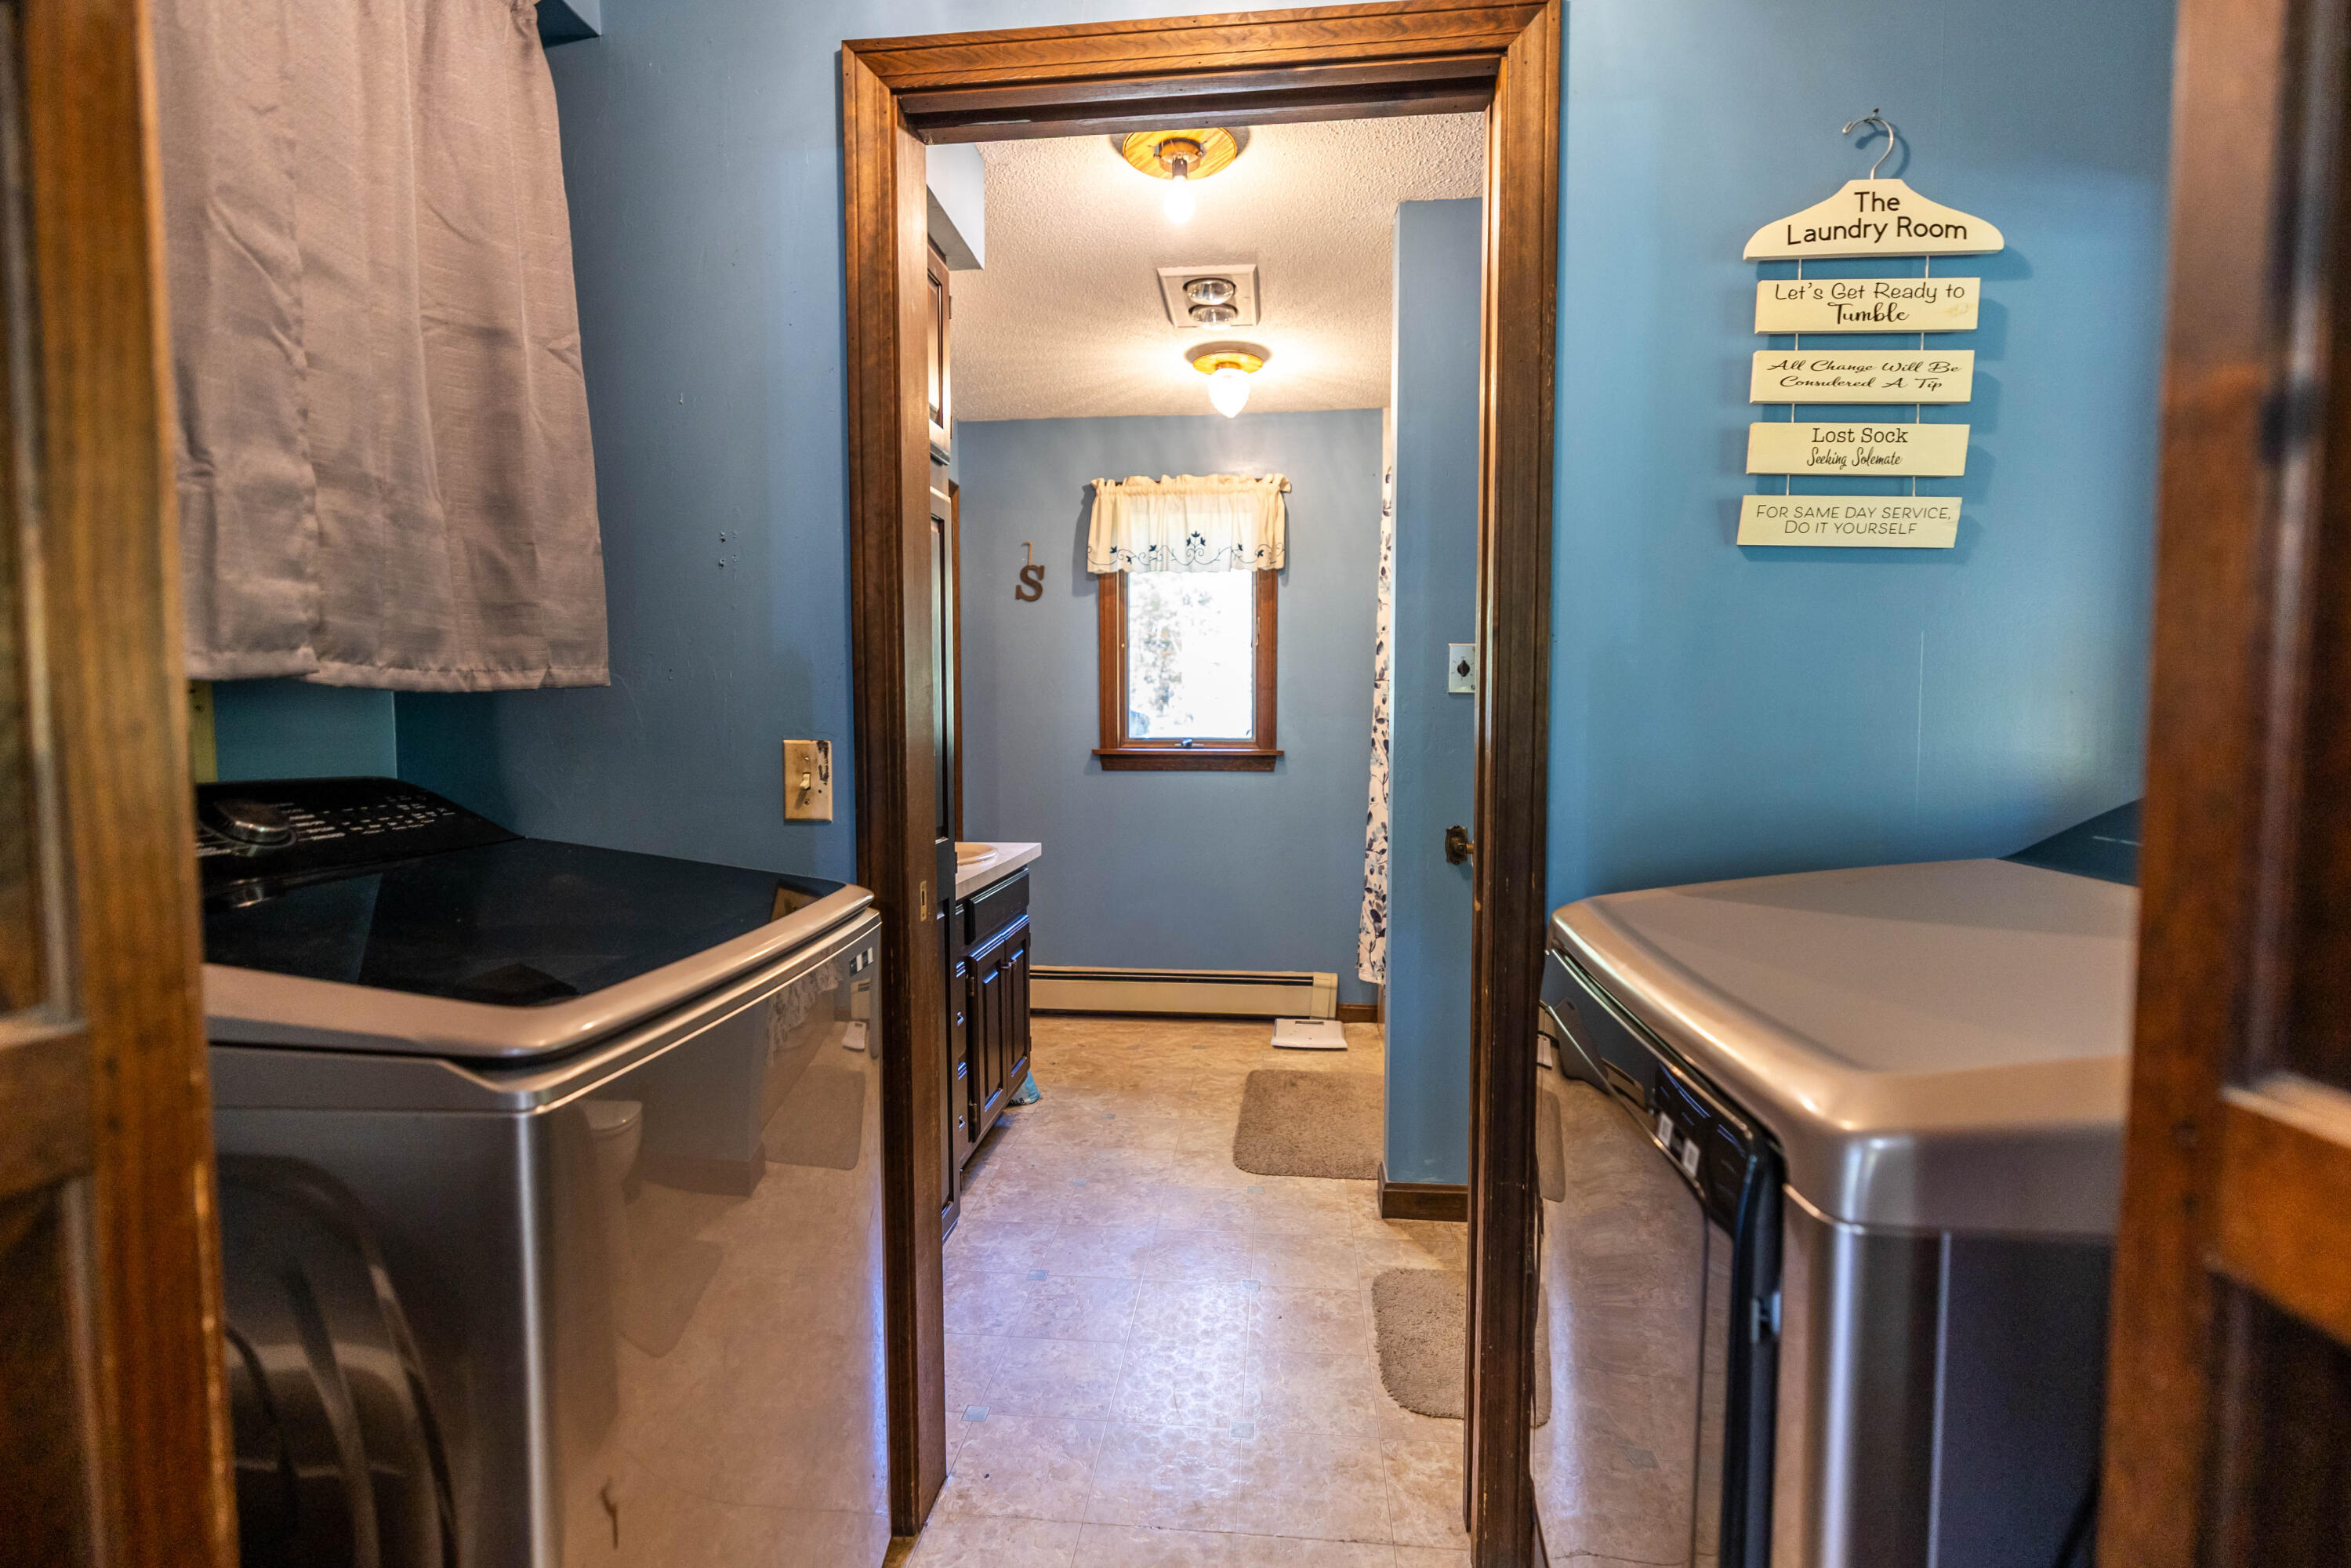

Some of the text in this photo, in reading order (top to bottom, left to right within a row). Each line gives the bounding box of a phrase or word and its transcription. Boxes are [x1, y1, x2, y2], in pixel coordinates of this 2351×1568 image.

[1853, 191, 1901, 212] The
[1787, 216, 1968, 245] Laundry Room
[1775, 281, 1965, 303] Let's Get Ready to
[1827, 301, 1910, 325] Tumble
[1767, 359, 1963, 374] All Change Will Be
[1780, 375, 1943, 392] Considered A Tip
[1811, 427, 1909, 444] Lost Sock
[1806, 446, 1903, 470] Seeking Solemate
[1794, 506, 1840, 519] SAME
[1845, 507, 1877, 519] DAY
[1881, 506, 1952, 521] SERVICE,
[1814, 522, 1827, 535] IT
[1833, 522, 1917, 535] YOURSELF
